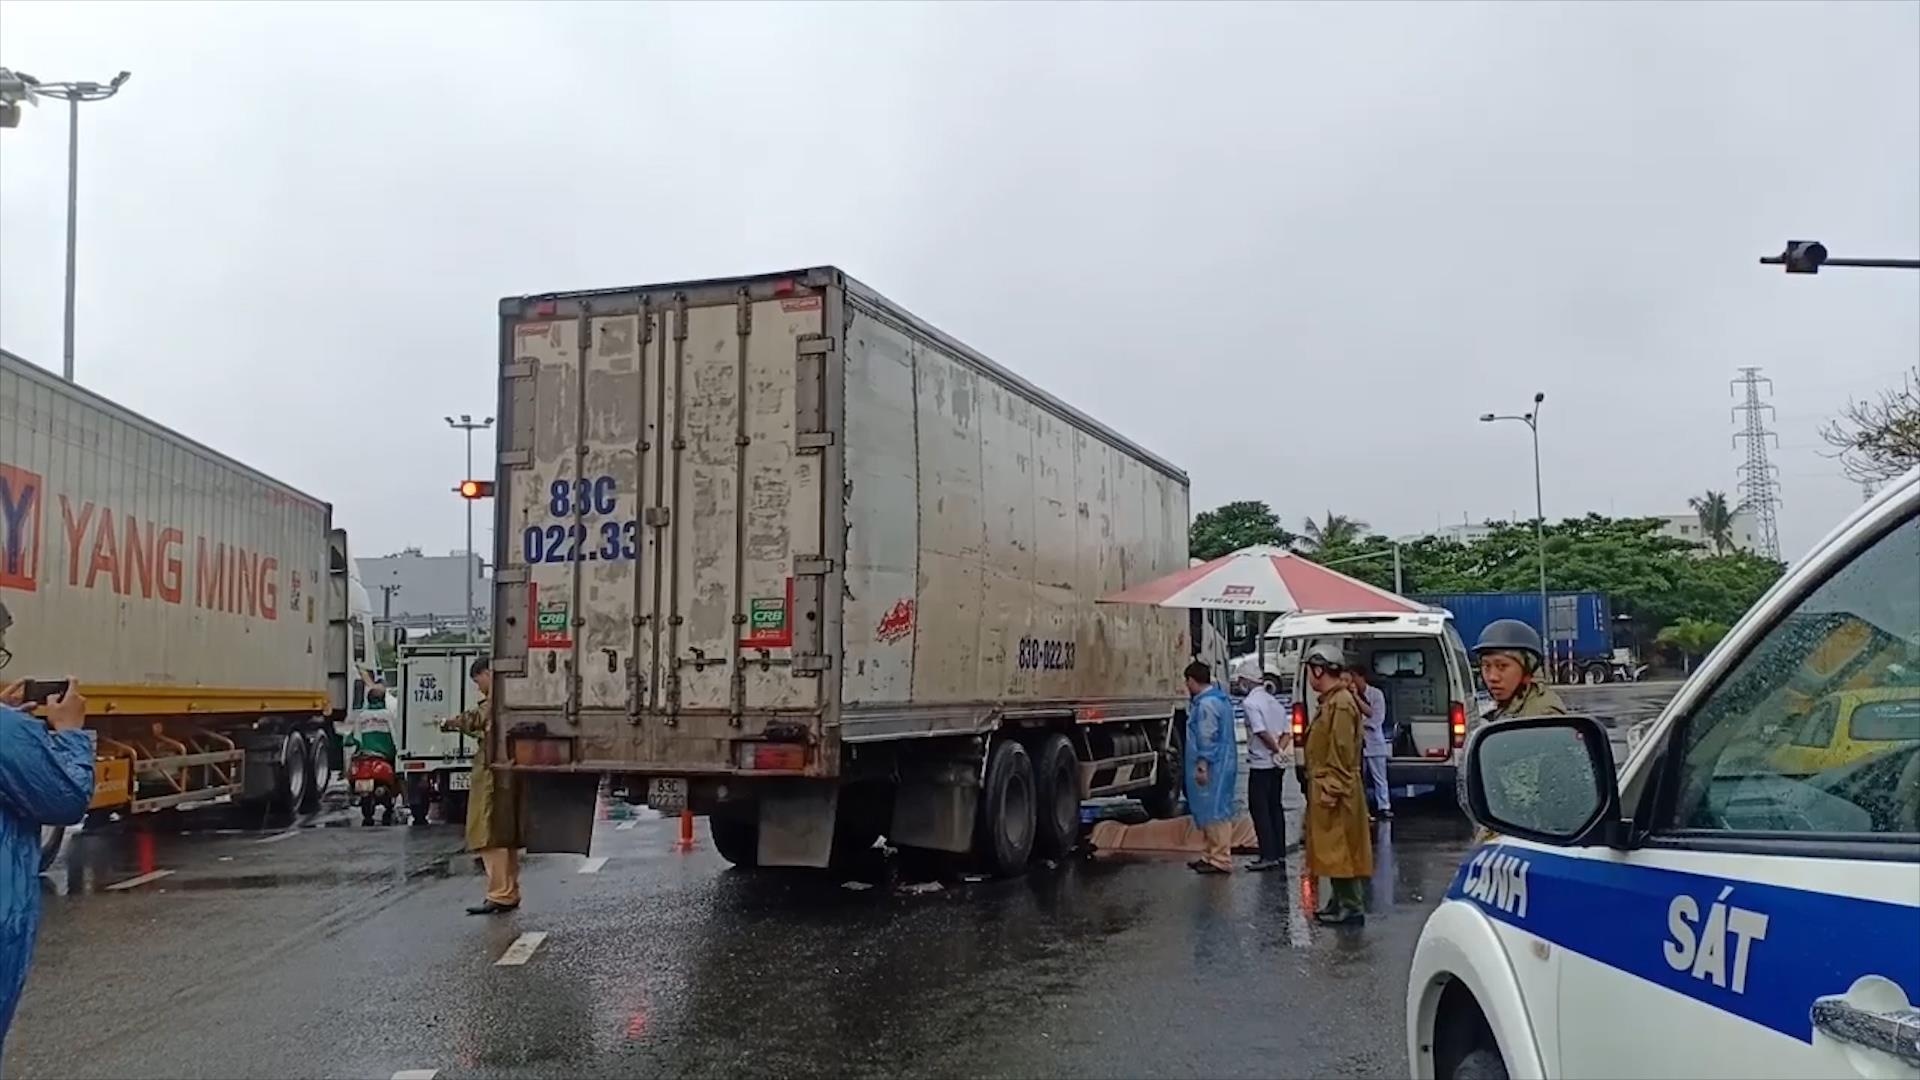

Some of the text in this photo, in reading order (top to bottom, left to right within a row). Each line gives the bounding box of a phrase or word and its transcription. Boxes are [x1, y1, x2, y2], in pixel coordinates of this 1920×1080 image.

[551, 476, 616, 517] 83C
[58, 493, 184, 606] YANG
[195, 535, 278, 621] MING
[524, 521, 640, 564] 022.33
[414, 689, 443, 702] 174.49
[419, 677, 437, 690] 43C
[1663, 885, 1769, 995] SÁT
